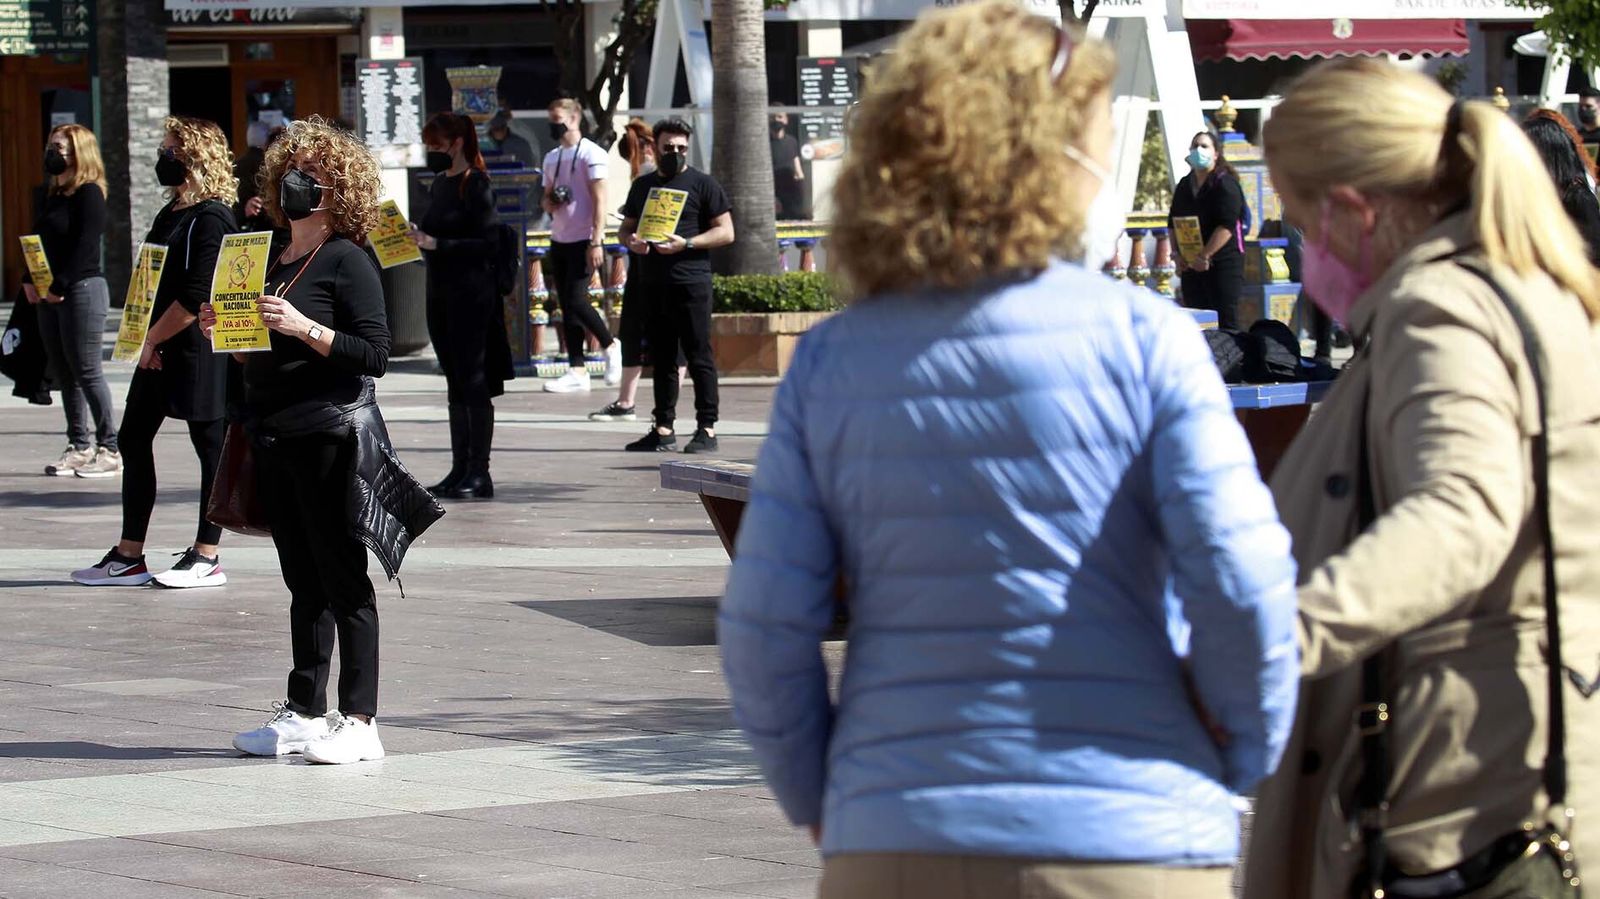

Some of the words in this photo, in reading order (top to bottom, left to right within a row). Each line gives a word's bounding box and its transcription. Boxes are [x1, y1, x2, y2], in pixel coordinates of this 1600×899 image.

[235, 239, 242, 247] 22
[242, 238, 250, 246] DE
[223, 301, 252, 311] NACIONAL
[222, 320, 234, 329] IVA
[235, 319, 241, 328] al
[241, 319, 256, 328] 10%
